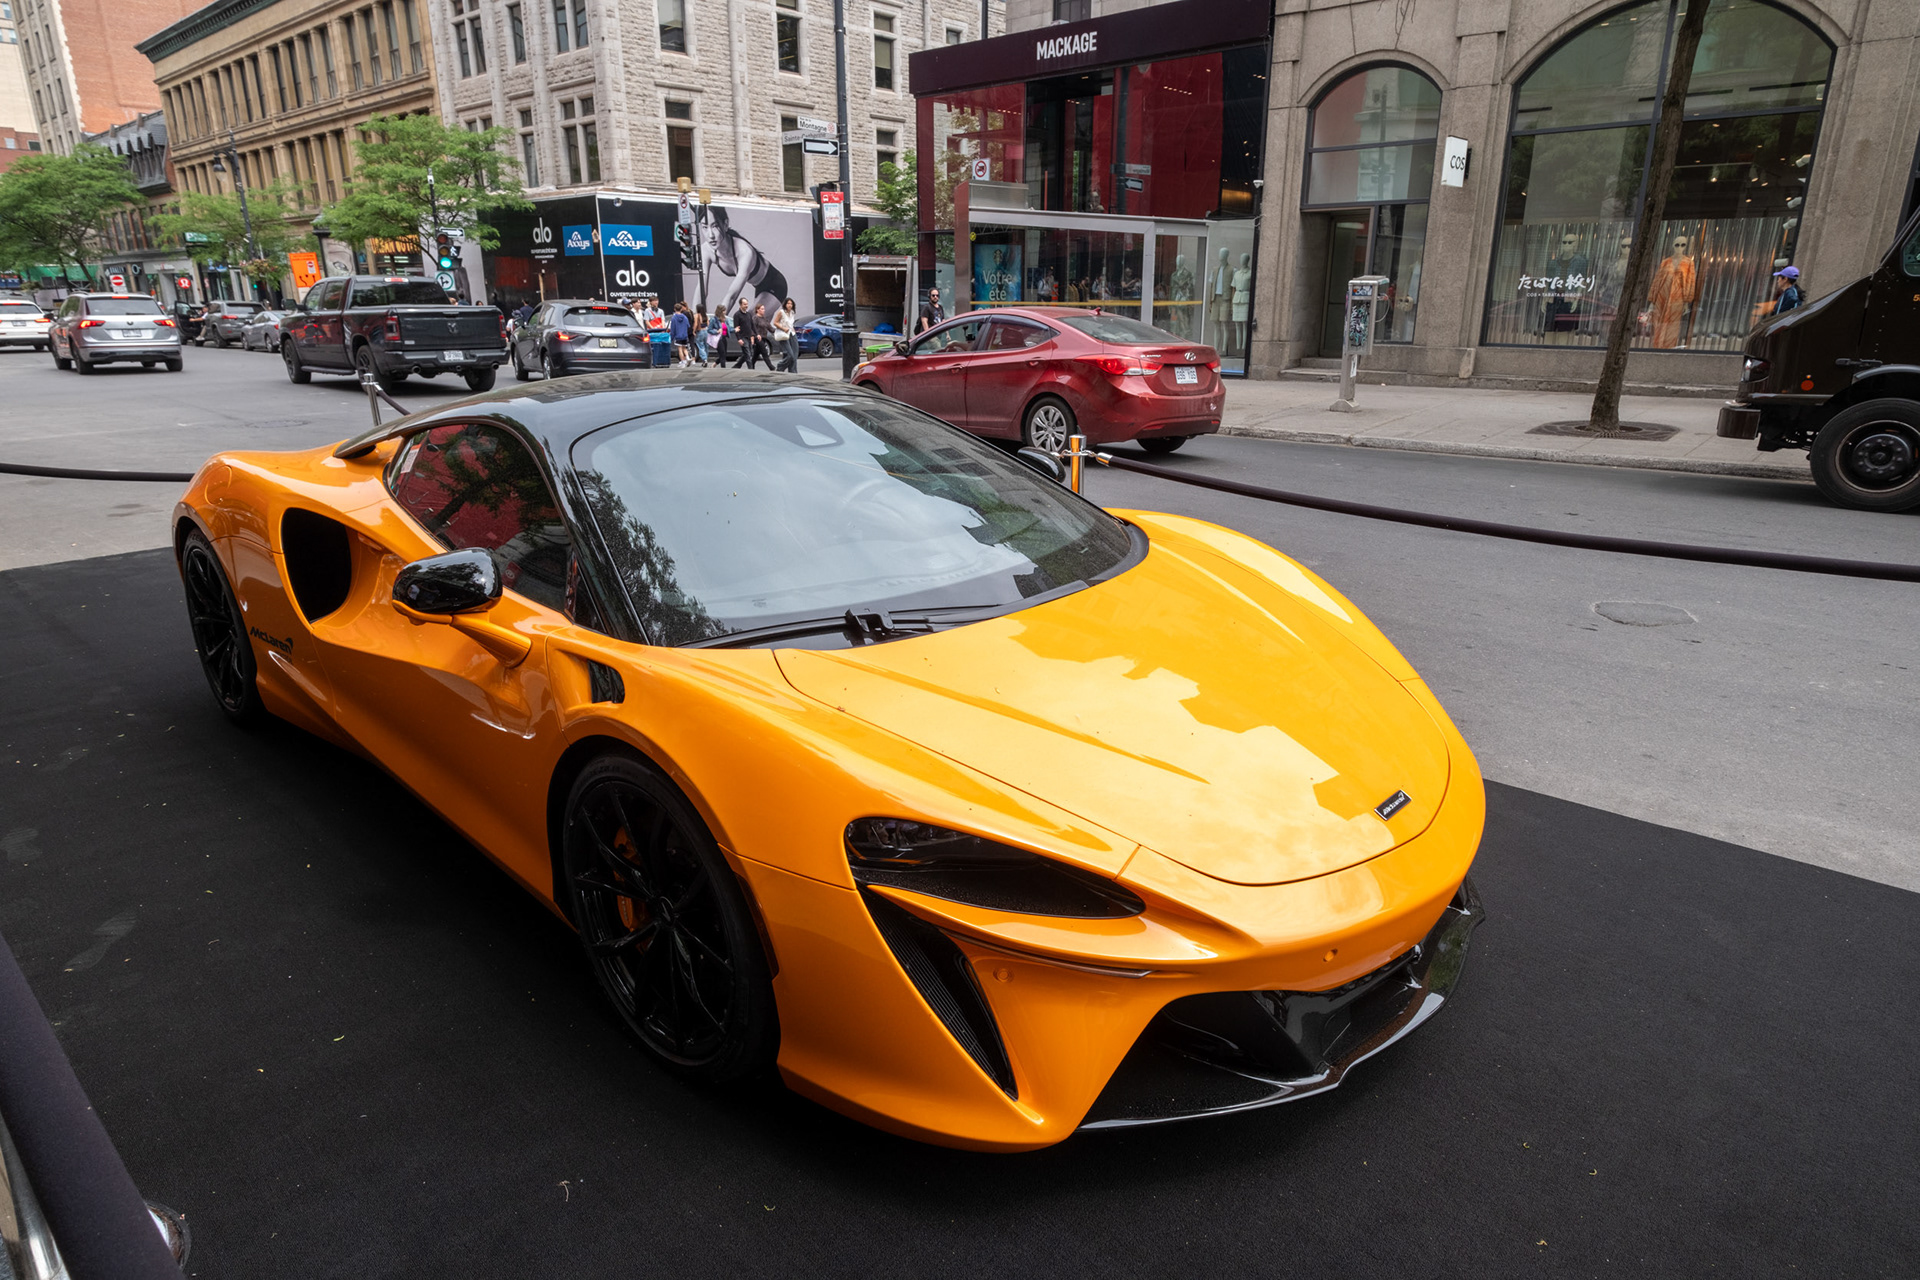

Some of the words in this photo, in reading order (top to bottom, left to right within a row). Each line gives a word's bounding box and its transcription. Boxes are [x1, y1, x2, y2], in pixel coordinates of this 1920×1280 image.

[1036, 31, 1098, 60] MACKAGE
[799, 120, 827, 132] Montagne
[1450, 155, 1466, 171] COS
[533, 217, 552, 243] alo
[567, 239, 590, 250] Axxys
[608, 238, 648, 249] Axxys
[616, 260, 650, 287] alo
[830, 266, 844, 289] al
[982, 270, 1013, 285] Votre
[988, 286, 1007, 301] été
[250, 626, 293, 655] McLaren
